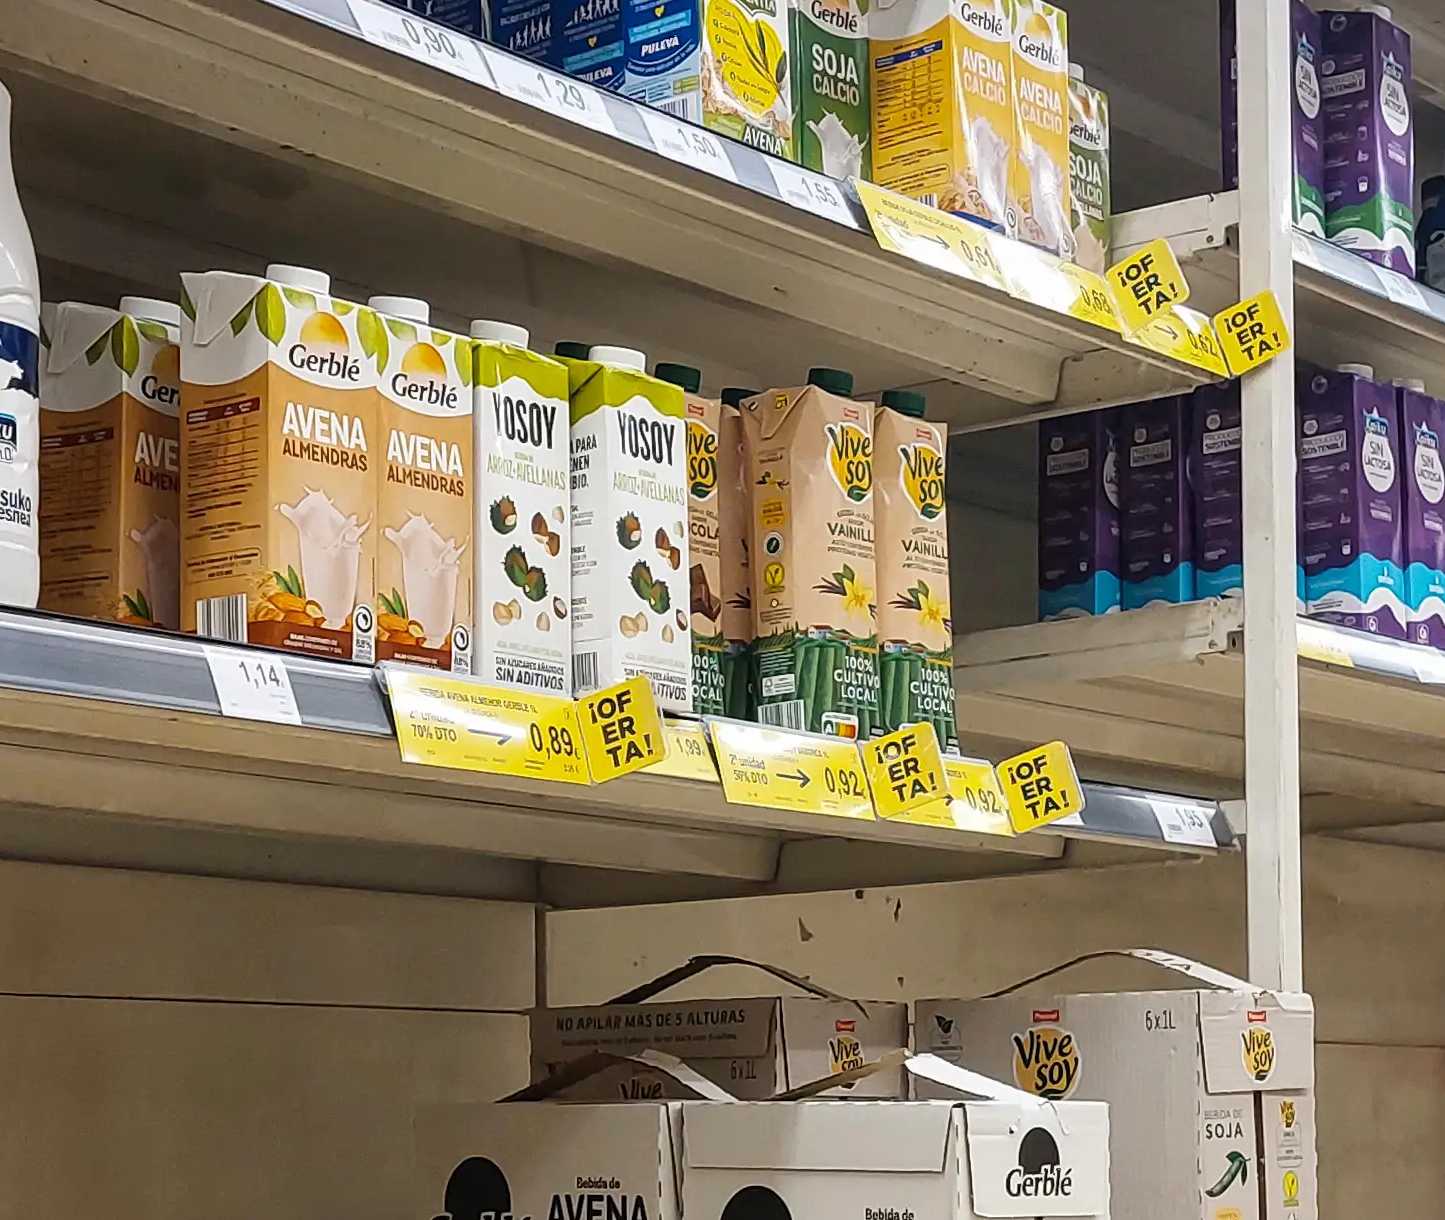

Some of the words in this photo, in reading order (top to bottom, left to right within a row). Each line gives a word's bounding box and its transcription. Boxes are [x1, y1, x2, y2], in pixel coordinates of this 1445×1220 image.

[811, 0, 857, 33] Gerblé
[961, 3, 1002, 36] Gerblé
[641, 36, 679, 56] PULEVA
[812, 43, 859, 84] SOJA
[962, 47, 1006, 86] AVENA
[813, 74, 860, 106] CALCIO
[963, 73, 1006, 106] CALCIO
[1020, 77, 1062, 115] AVENA
[1021, 105, 1062, 135] CALCIO
[744, 127, 782, 155] AVENA
[289, 343, 360, 381] Gerblé
[391, 372, 458, 408] Gerblé
[282, 402, 368, 452] AVENA
[492, 392, 557, 449] YOSOY
[576, 434, 597, 449] PARA
[617, 410, 675, 467] YOSOY
[830, 424, 872, 459] Vive
[282, 439, 368, 472] ALMENDRAS
[387, 429, 464, 477] AVENA
[904, 447, 943, 479] Vive
[387, 464, 464, 497] ALMENDRAS
[827, 522, 874, 543] VAINILL
[901, 539, 949, 559] VAINILL
[845, 655, 874, 673] 100%
[921, 668, 948, 684] 100%
[495, 667, 517, 682] SIN
[519, 669, 563, 690] ADITIVOS
[834, 670, 880, 688] CULTIVO
[910, 681, 955, 699] CULTIVO
[841, 685, 877, 702] LOCAL
[918, 697, 953, 714] LOCAL
[602, 716, 636, 744] ER
[887, 757, 920, 783] ER
[1020, 776, 1051, 801] ER
[556, 1017, 573, 1031] NO
[577, 1015, 621, 1031] APILAR
[625, 1011, 652, 1028] MÁS
[656, 1013, 674, 1027] DE
[675, 1013, 682, 1026] 5
[687, 1009, 746, 1025] ALTURAS
[829, 1041, 860, 1063] Vive
[1013, 1031, 1073, 1068] Vive
[1243, 1029, 1272, 1055] Vive
[1253, 1050, 1275, 1073] soy
[1035, 1057, 1079, 1095] soy
[1205, 1121, 1244, 1140] SOJA
[576, 1177, 607, 1189] Bebida
[609, 1178, 620, 1189] de
[1005, 1167, 1073, 1198] Gerblé
[865, 1207, 897, 1220] Bebida
[900, 1209, 914, 1220] de
